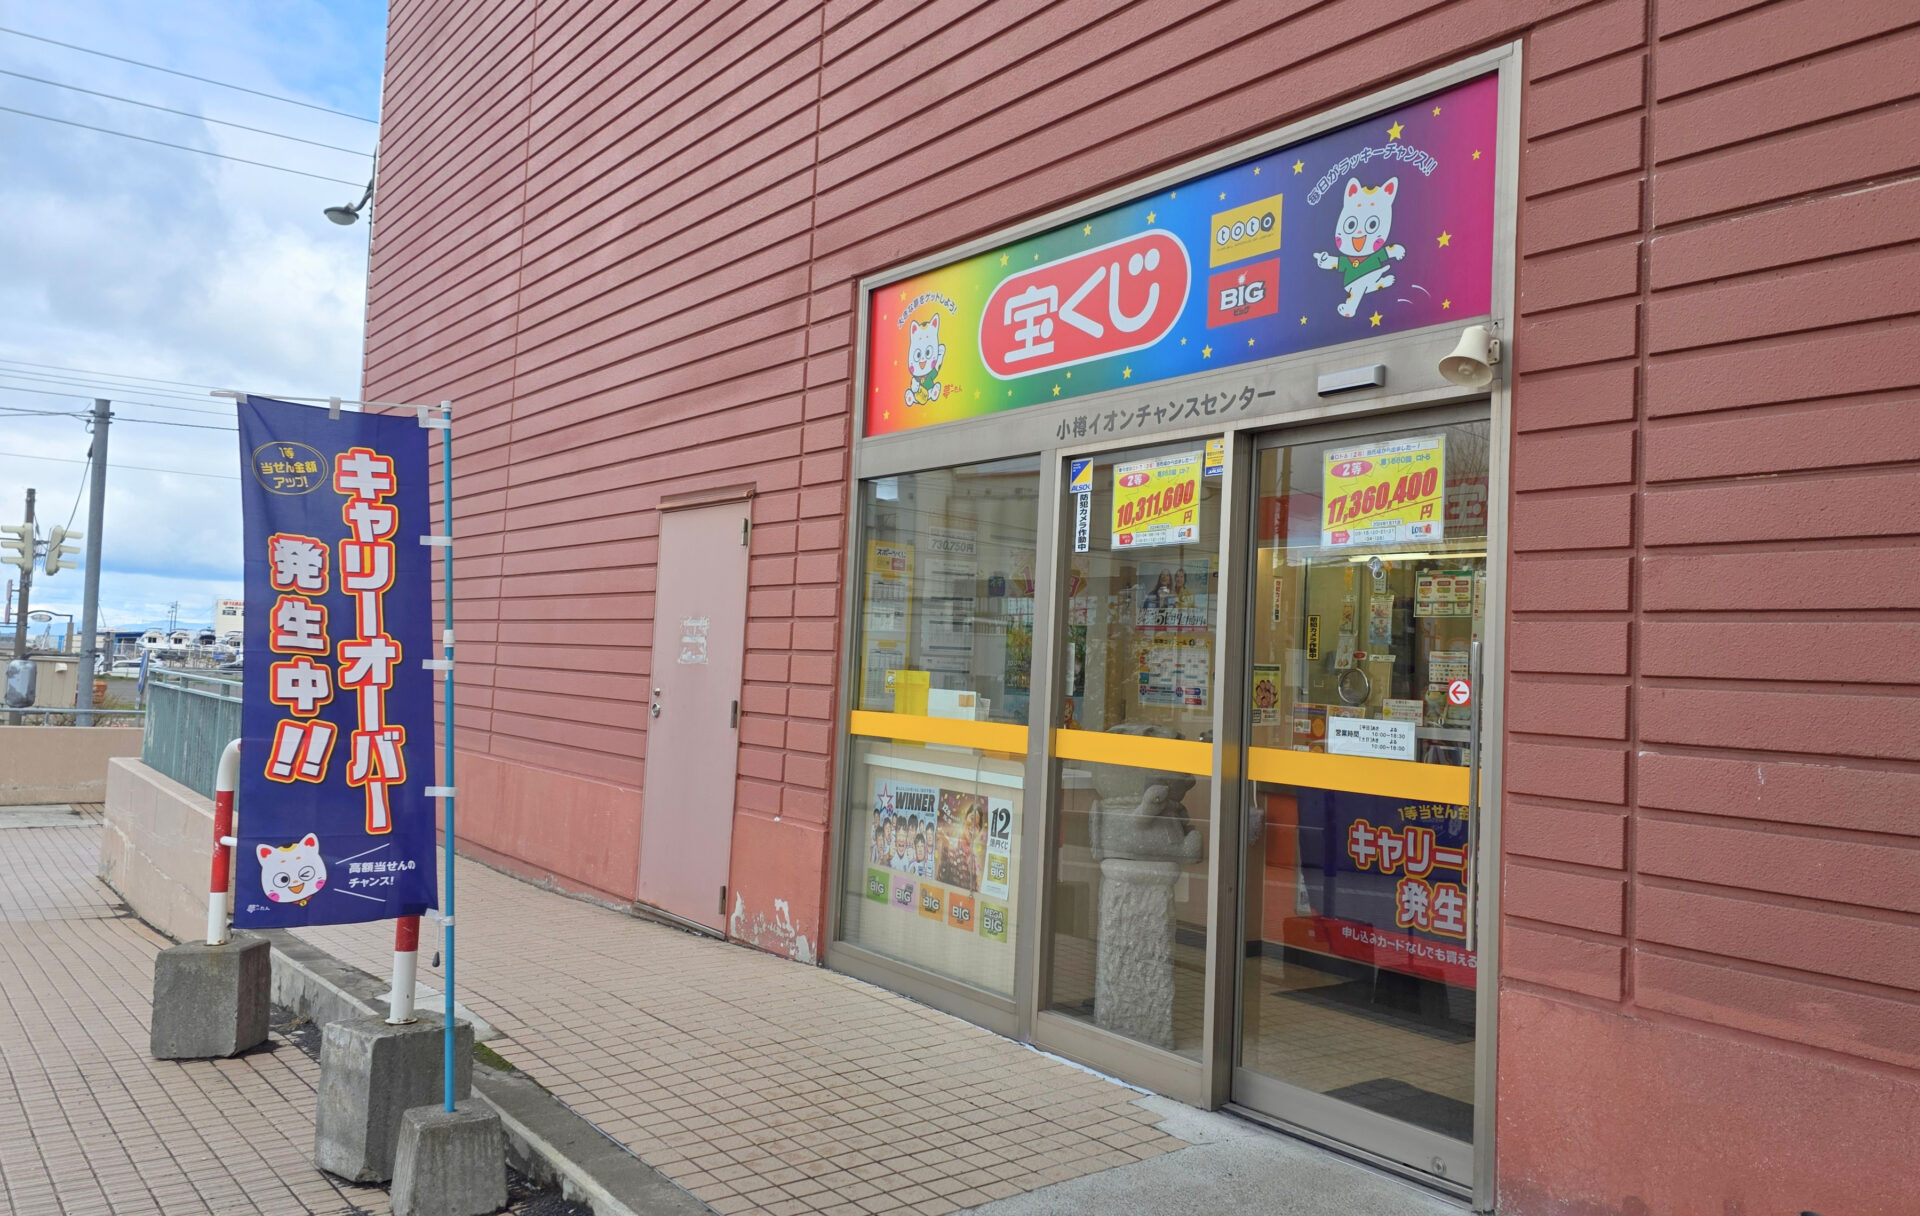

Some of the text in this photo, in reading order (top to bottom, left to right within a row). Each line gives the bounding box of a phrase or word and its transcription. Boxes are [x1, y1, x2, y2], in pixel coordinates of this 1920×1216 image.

[1217, 212, 1275, 245] toto
[1219, 279, 1266, 311] BIG
[1004, 248, 1160, 363] 宝くじ
[1056, 385, 1277, 441] 小樽イオンチャンスセンター
[260, 460, 318, 474] 当せん金額
[1342, 462, 1362, 477] 2等
[1127, 473, 1142, 487] 2等
[1117, 479, 1195, 528] 10,311,600
[1328, 467, 1438, 525] 17,360,400
[1183, 509, 1192, 524] 円
[1420, 503, 1433, 520] 円
[1078, 494, 1088, 550] 防犯カメラ作動中
[335, 448, 405, 833] キャリーオーバー
[1309, 616, 1318, 658] 防犯カメラ作動中
[266, 533, 336, 782] 発生中!!
[1335, 729, 1360, 738] 営業時間
[895, 791, 936, 813] WINNER
[990, 807, 1011, 840] 12
[349, 861, 416, 874] 高額当せんの
[990, 868, 1005, 878] BIG
[349, 876, 395, 888] チャンス!
[870, 880, 885, 894] BIG
[896, 888, 911, 902] BIG
[922, 896, 940, 910] BIG
[952, 905, 970, 920] BIG
[983, 907, 1004, 919] MEGA
[983, 917, 1004, 933] BIG
[1341, 927, 1478, 969] 申し込みカードなしでも買える
